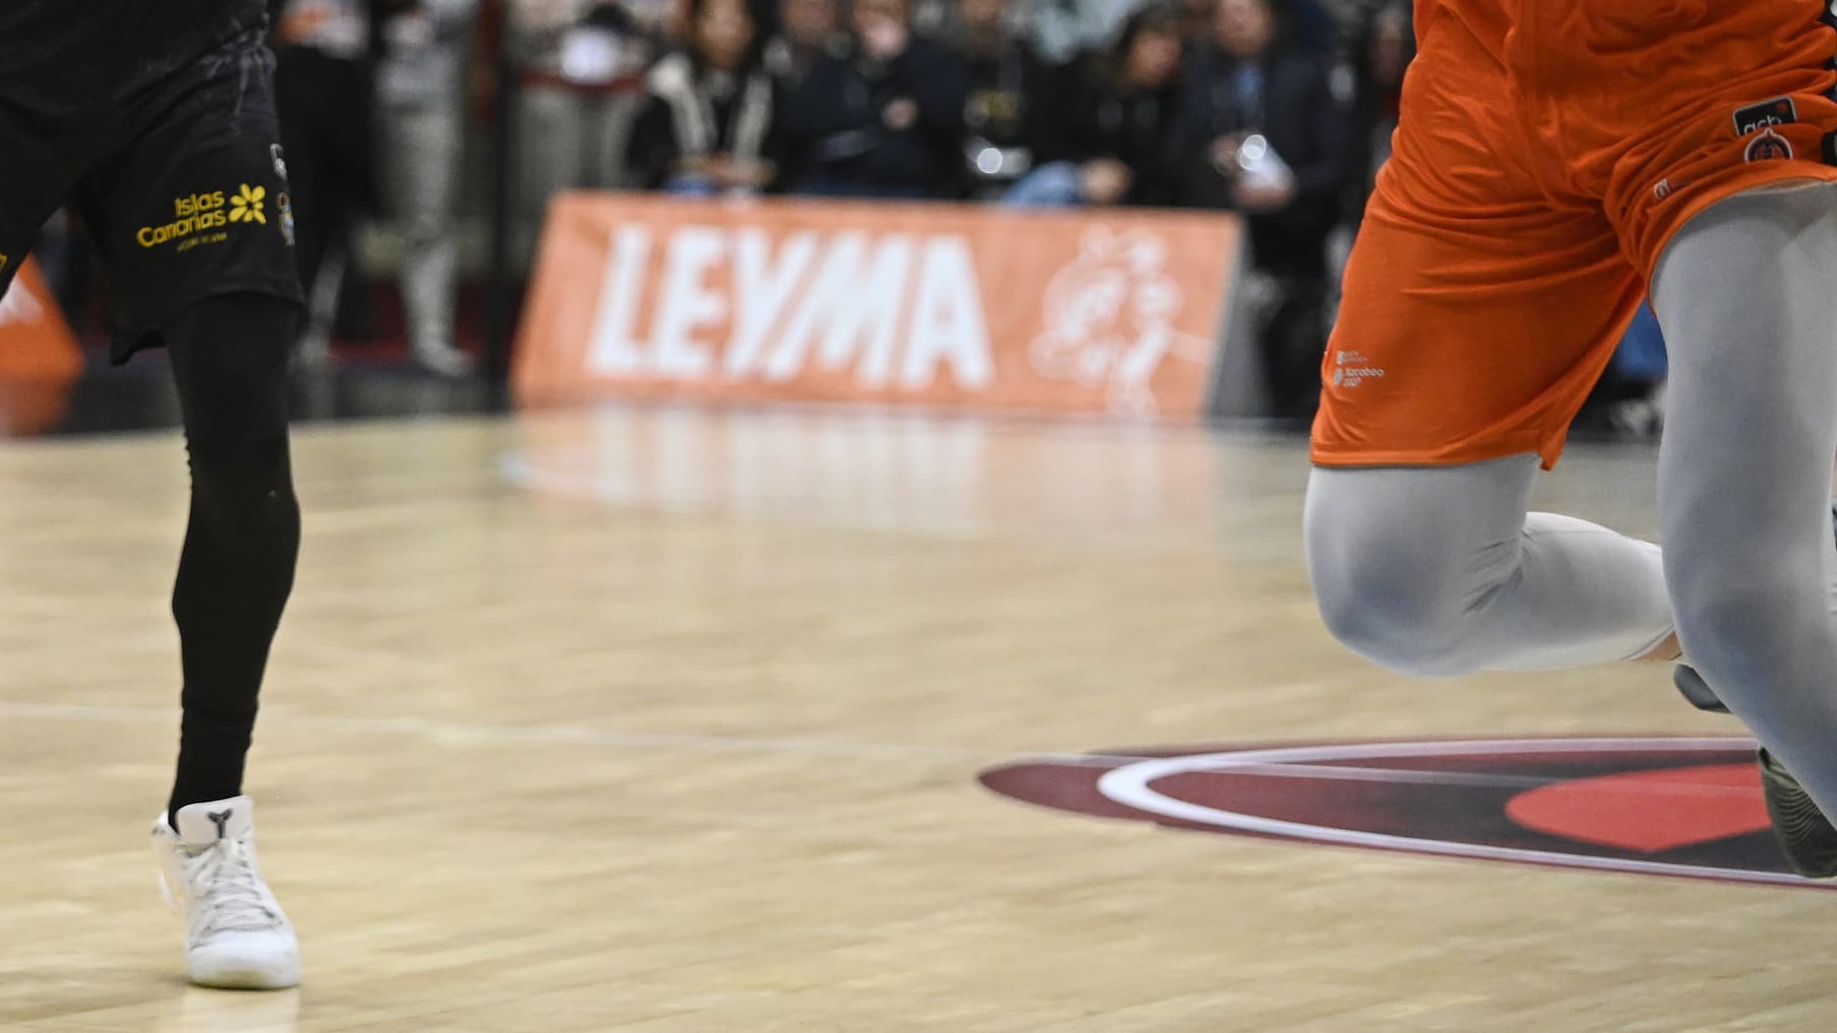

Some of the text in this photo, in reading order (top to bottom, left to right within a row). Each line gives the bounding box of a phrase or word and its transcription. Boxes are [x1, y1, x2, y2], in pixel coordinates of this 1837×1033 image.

[174, 190, 225, 217] Islas
[136, 209, 228, 248] Canarias
[586, 222, 996, 389] LEYMA
